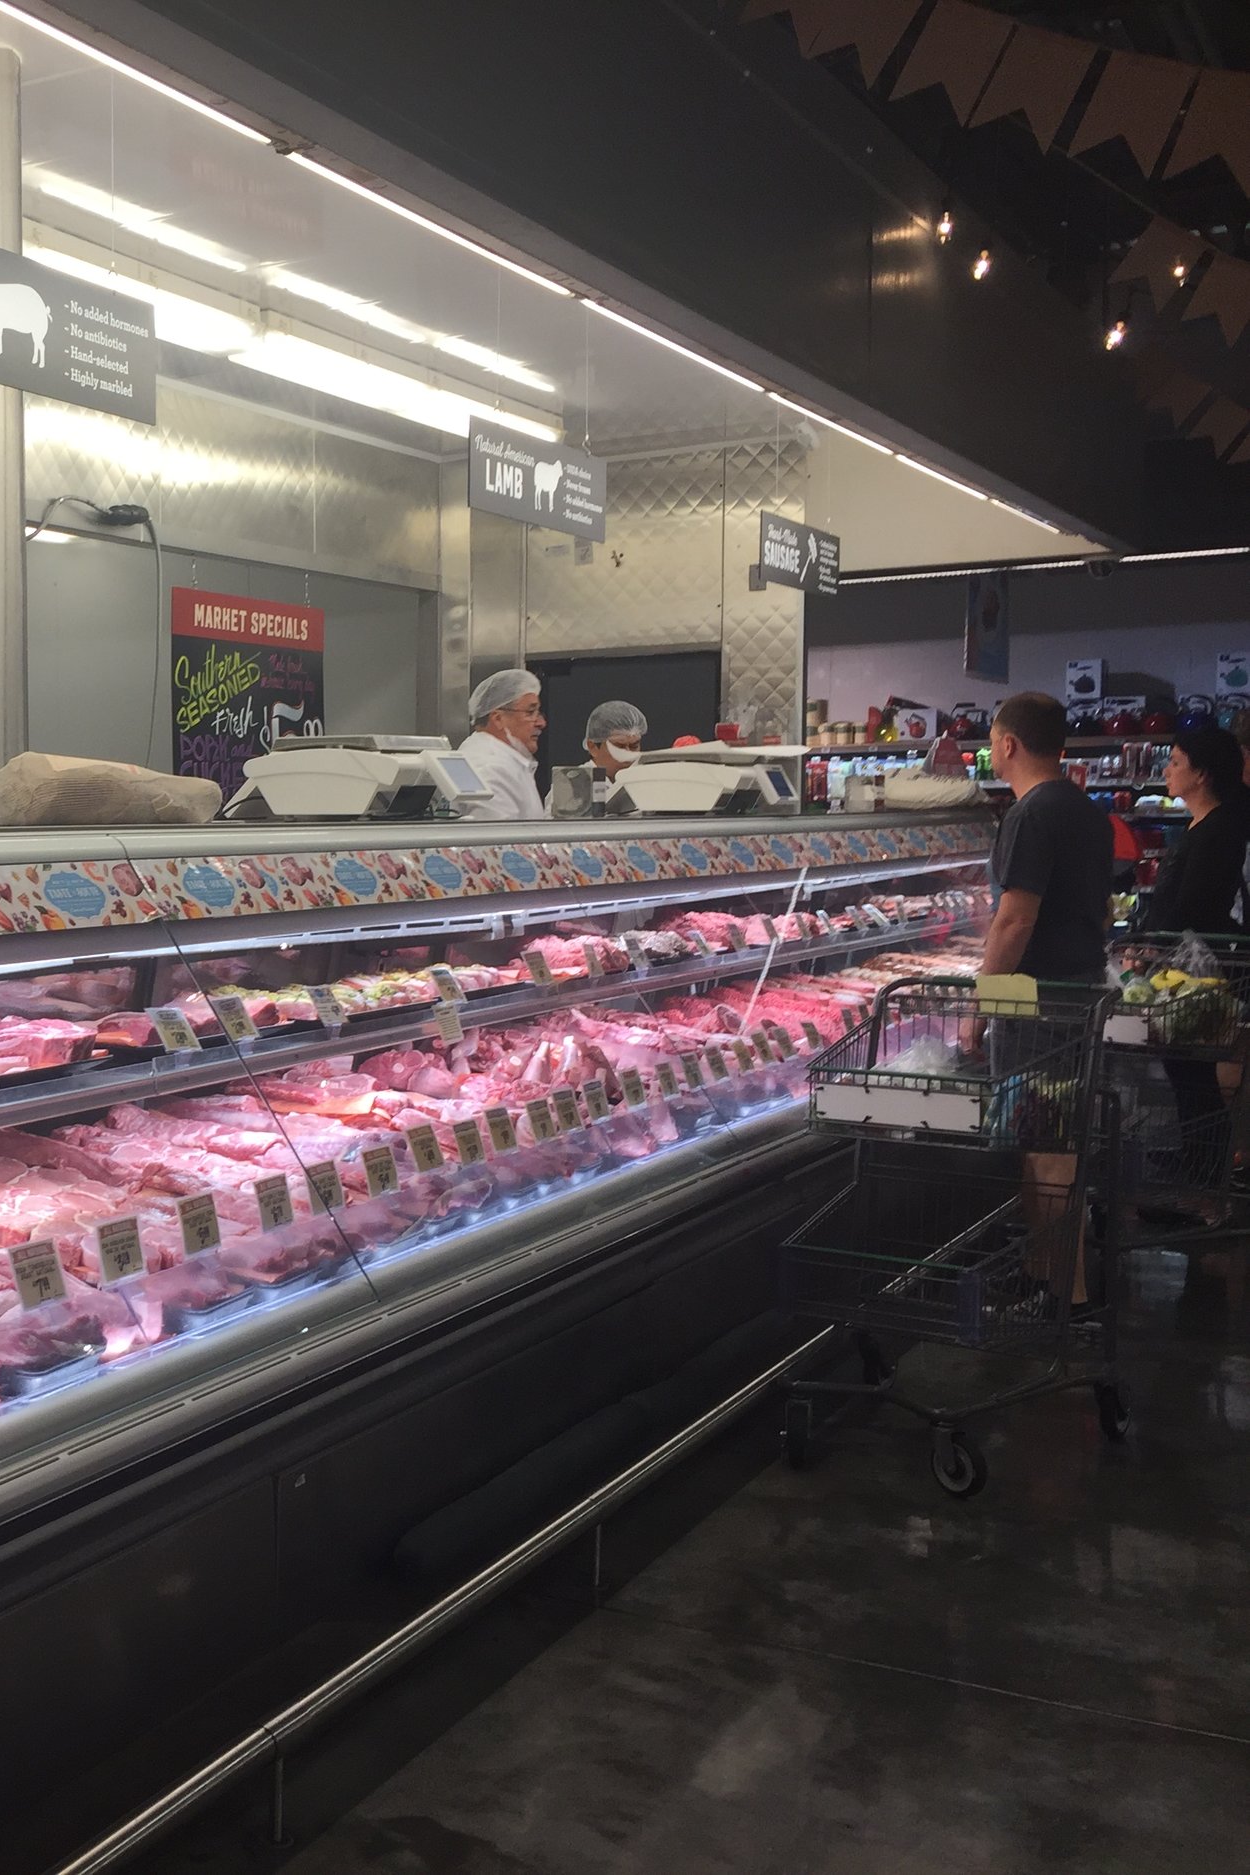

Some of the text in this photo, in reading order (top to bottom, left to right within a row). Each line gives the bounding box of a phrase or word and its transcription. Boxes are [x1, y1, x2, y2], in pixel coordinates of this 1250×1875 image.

[70, 300, 149, 338] No added hormones
[70, 323, 127, 352] No antibiotics
[70, 345, 129, 374] Hand-selected
[70, 368, 133, 397] Highly marbled
[485, 458, 523, 500] LAMB
[764, 540, 801, 574] SAUSAGE
[194, 603, 309, 641] MARKET SPECIALS
[176, 663, 261, 733] SEASONED
[211, 696, 259, 738] Fresh
